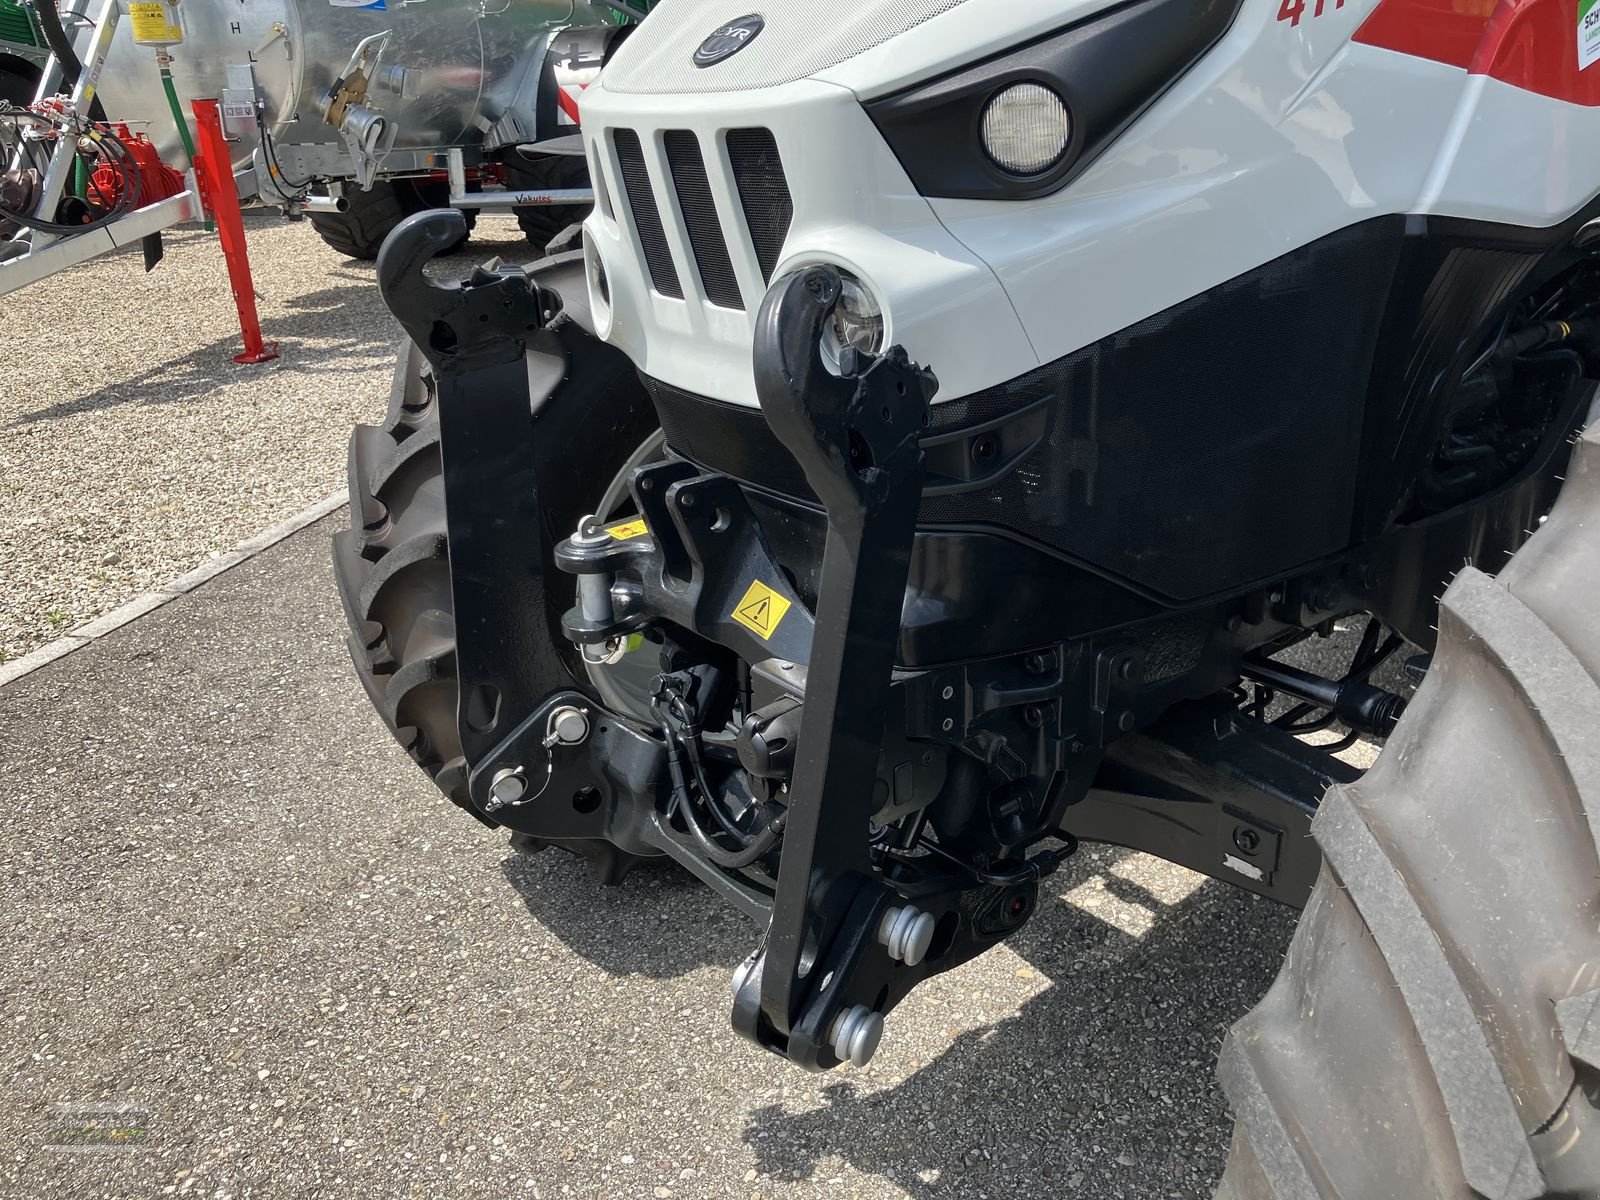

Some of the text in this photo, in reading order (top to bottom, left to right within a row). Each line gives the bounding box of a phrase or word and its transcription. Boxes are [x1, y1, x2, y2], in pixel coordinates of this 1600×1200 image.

[1584, 8, 1600, 30] SCH
[230, 22, 241, 35] H
[248, 50, 258, 63] L
[515, 193, 553, 204] Vakutec
